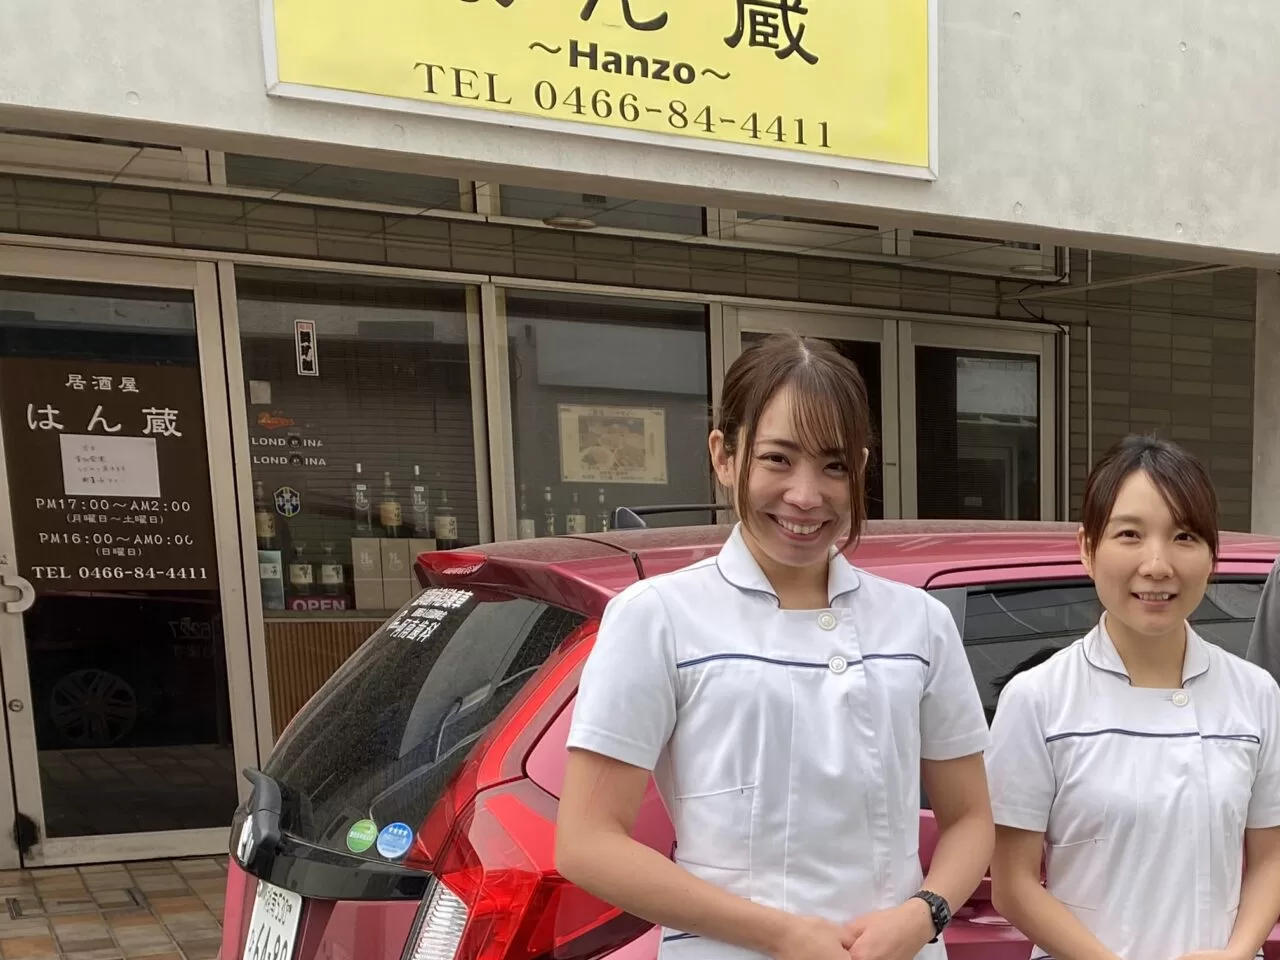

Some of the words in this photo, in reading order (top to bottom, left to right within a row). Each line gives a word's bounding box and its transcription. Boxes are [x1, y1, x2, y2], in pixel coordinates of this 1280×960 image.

[412, 62, 513, 106] TEL
[534, 80, 832, 149] 0466-84-4411
[65, 374, 139, 392] 居酒屋
[27, 403, 182, 437] はん蔵
[32, 566, 71, 579] TEL
[79, 566, 207, 579] 0466-84-4411
[292, 599, 345, 610] OPEN
